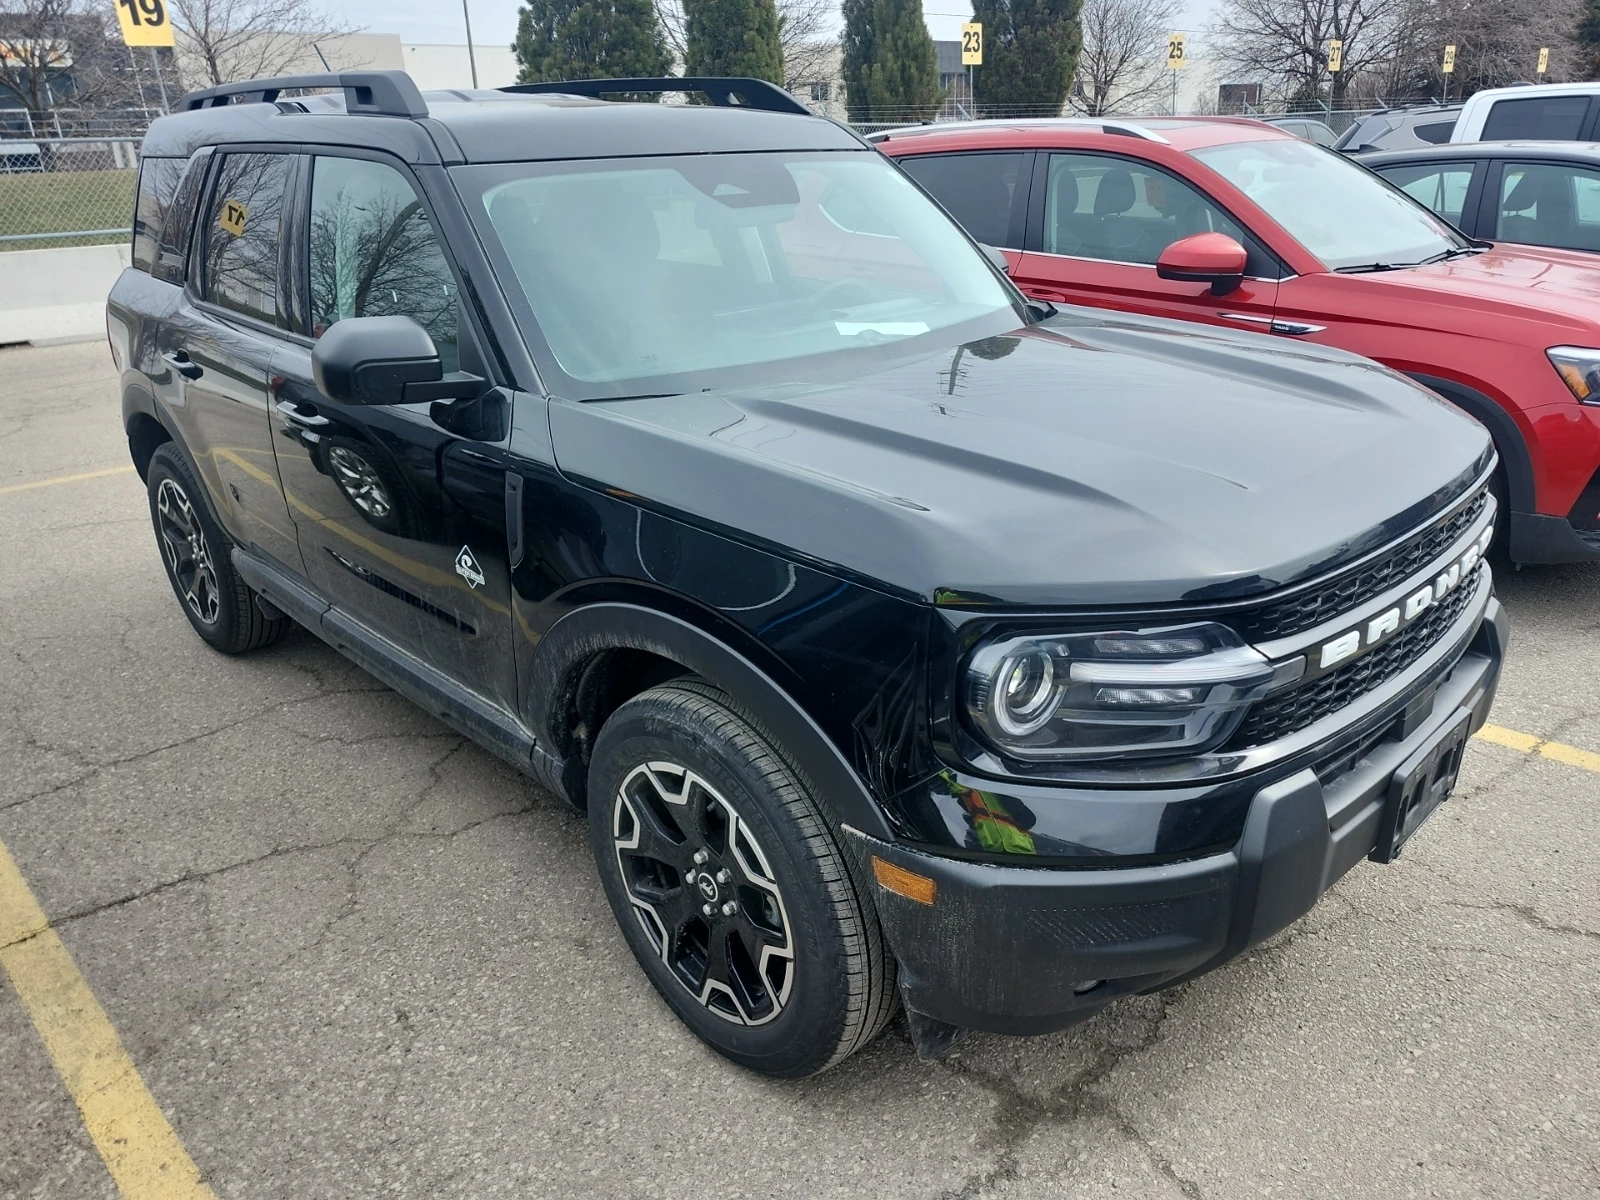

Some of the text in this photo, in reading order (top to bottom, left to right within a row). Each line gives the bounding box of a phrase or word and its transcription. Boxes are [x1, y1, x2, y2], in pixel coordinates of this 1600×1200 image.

[120, 0, 165, 27] 19
[963, 31, 980, 53] 23
[1169, 41, 1183, 59] 25
[1330, 46, 1340, 62] 27
[1445, 50, 1454, 64] 29
[1539, 52, 1547, 66] 31
[1320, 525, 1493, 669] BRONCO
[705, 757, 781, 852] MICHELIN
